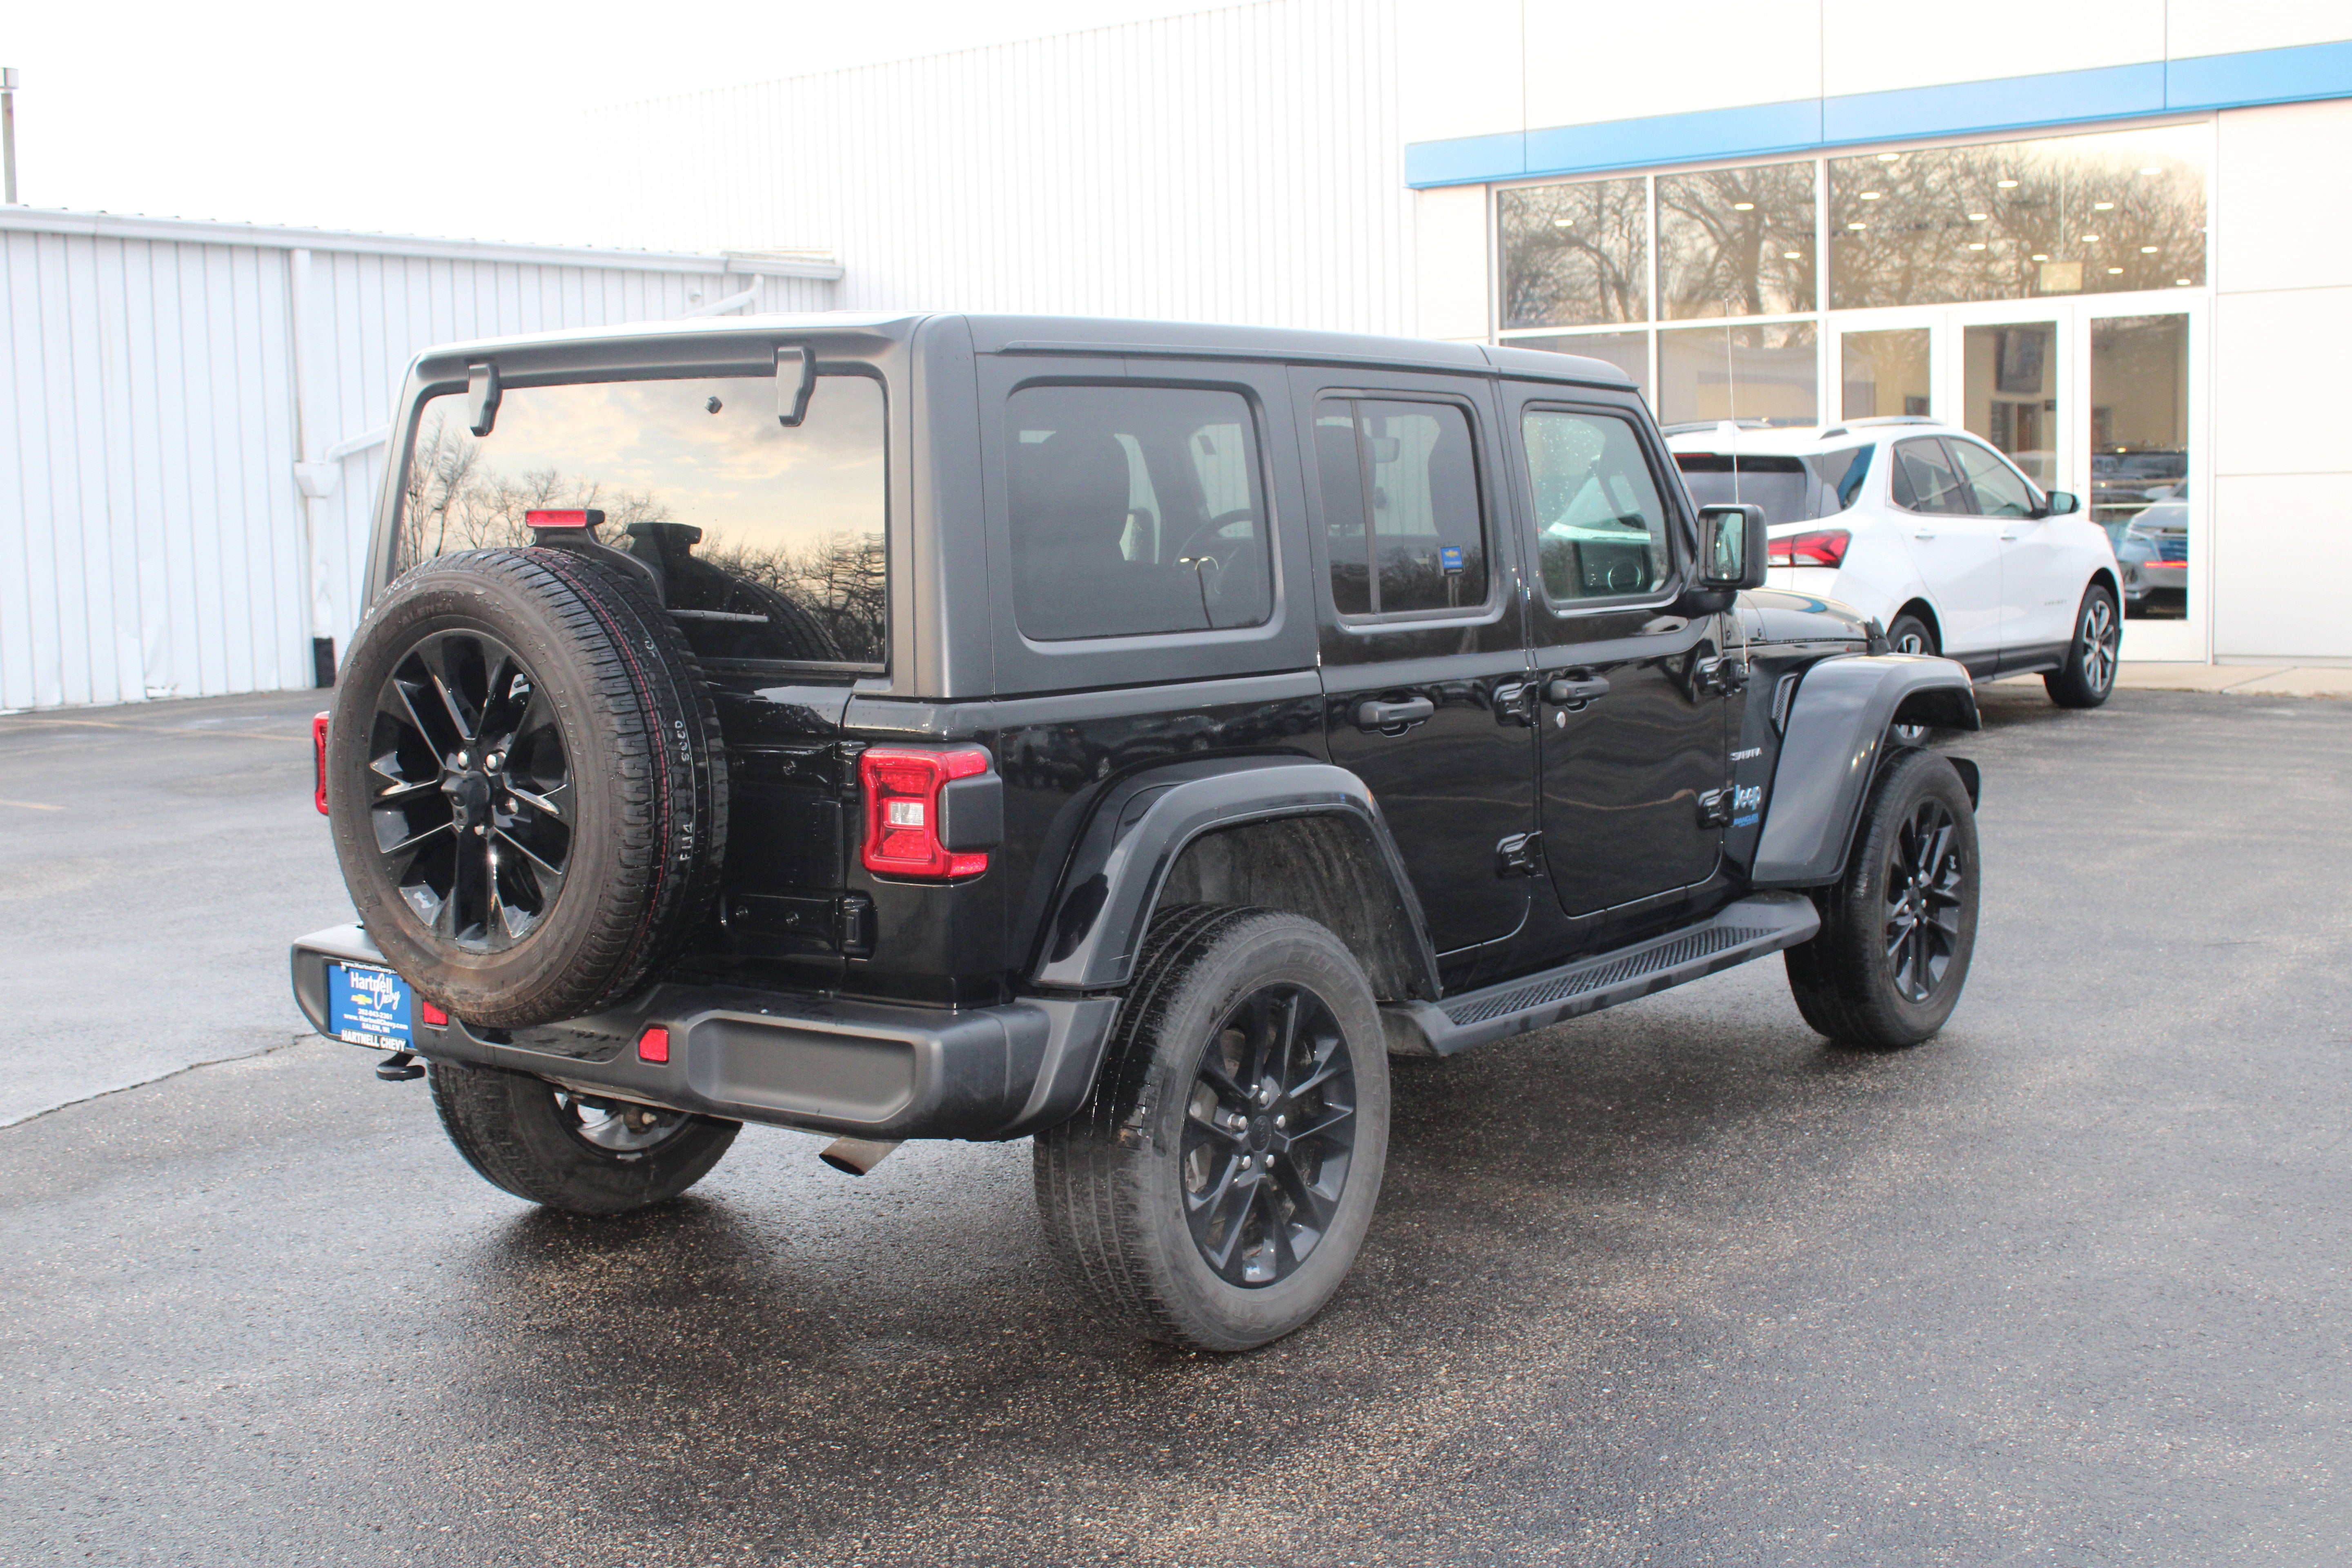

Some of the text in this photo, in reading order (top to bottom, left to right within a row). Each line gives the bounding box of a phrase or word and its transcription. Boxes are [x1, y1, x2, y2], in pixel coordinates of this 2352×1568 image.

[1733, 784, 1762, 811] Jeep
[350, 971, 392, 994] Hartnell
[341, 1029, 406, 1052] HARTNELL CHEVY
